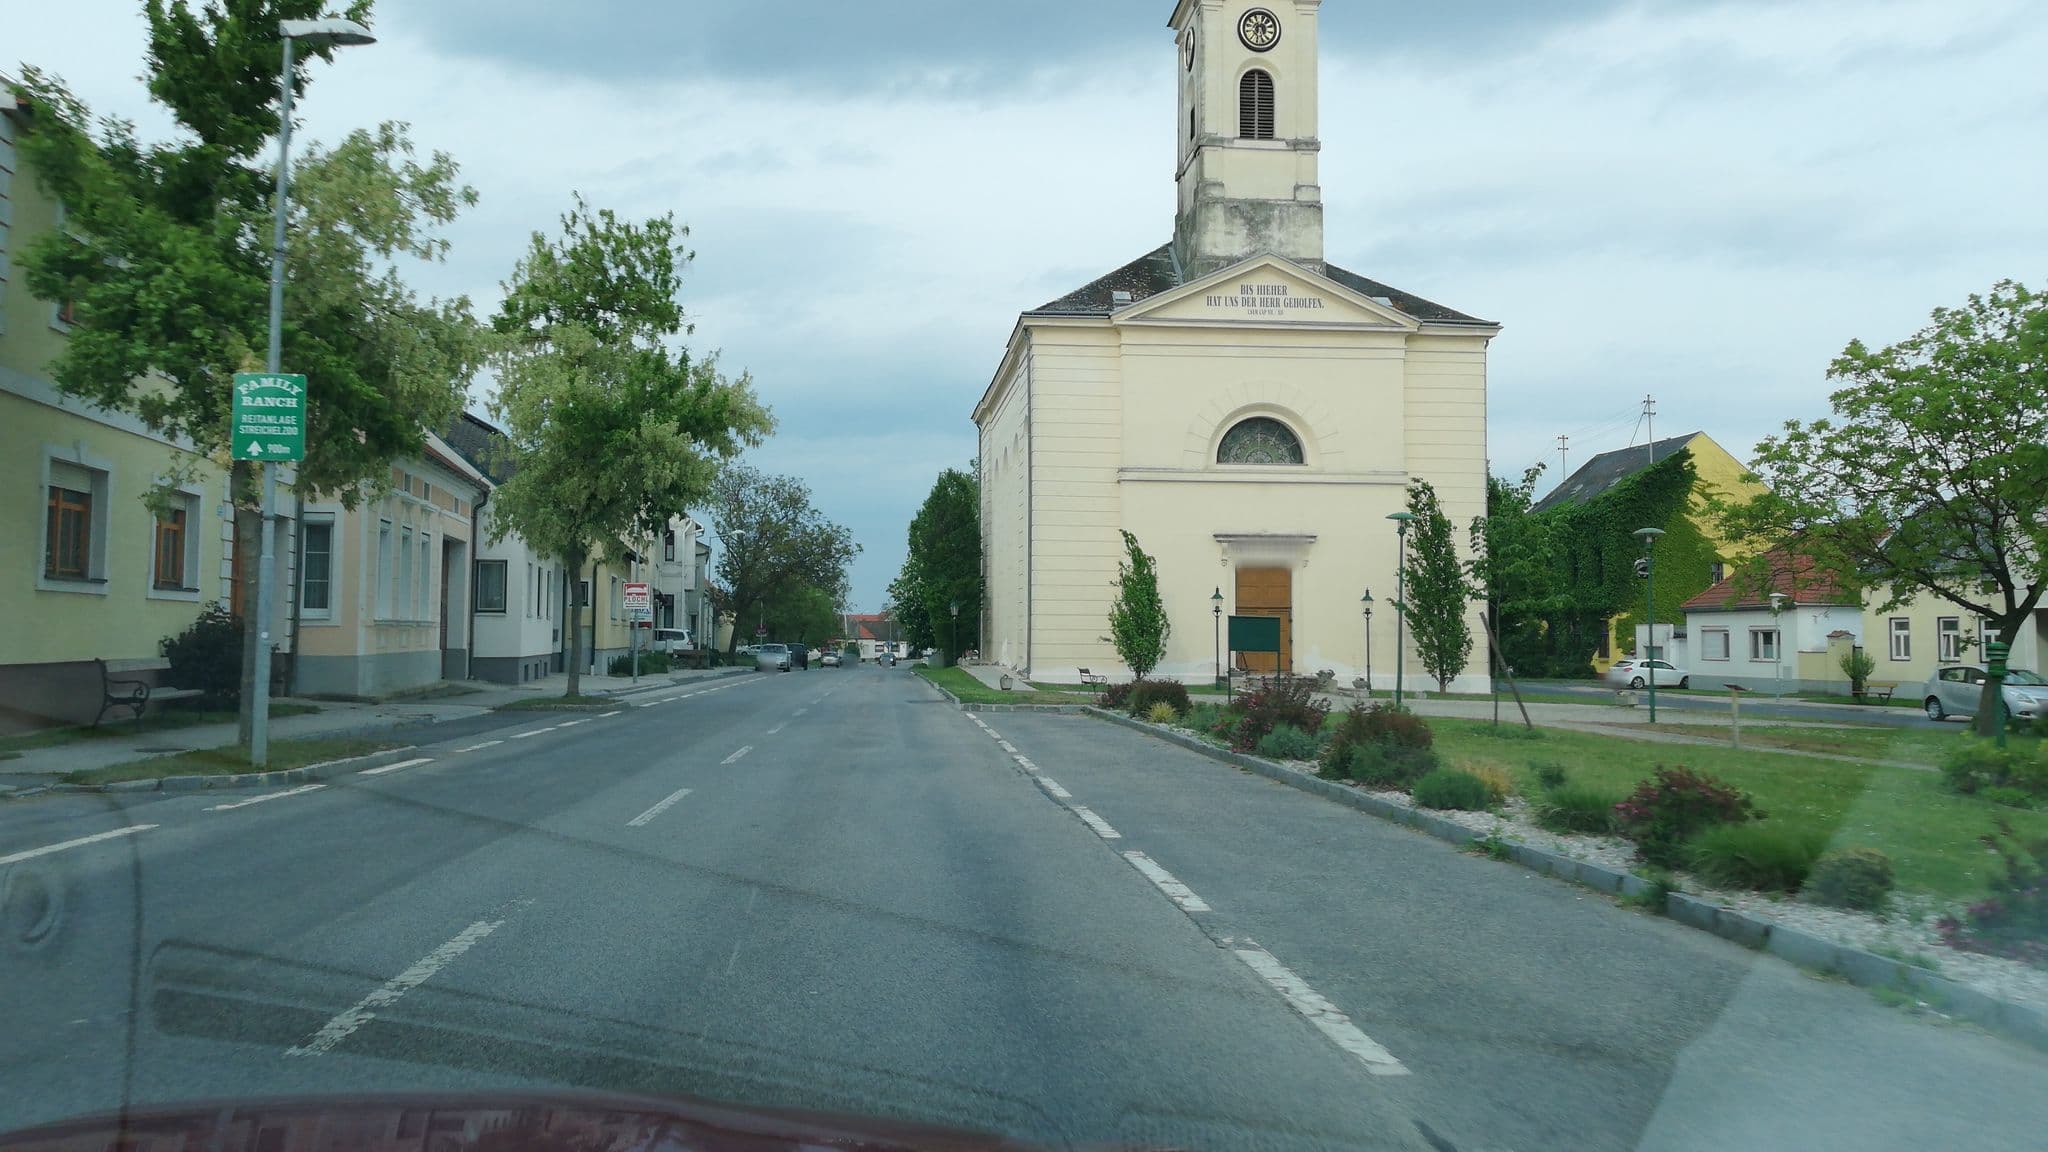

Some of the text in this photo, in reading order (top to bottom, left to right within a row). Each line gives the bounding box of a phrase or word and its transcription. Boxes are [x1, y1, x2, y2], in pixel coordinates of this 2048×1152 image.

[1240, 284, 1288, 296] BIS HIEHER
[1206, 295, 1222, 307] HAT
[1224, 296, 1239, 307] UNS
[1241, 297, 1257, 308] DER
[1259, 297, 1281, 308] HERR
[237, 377, 303, 396] FAMILY
[241, 396, 298, 407] RANCH
[241, 414, 298, 425] REITANLAGE
[239, 425, 299, 436] STREICHELZOO
